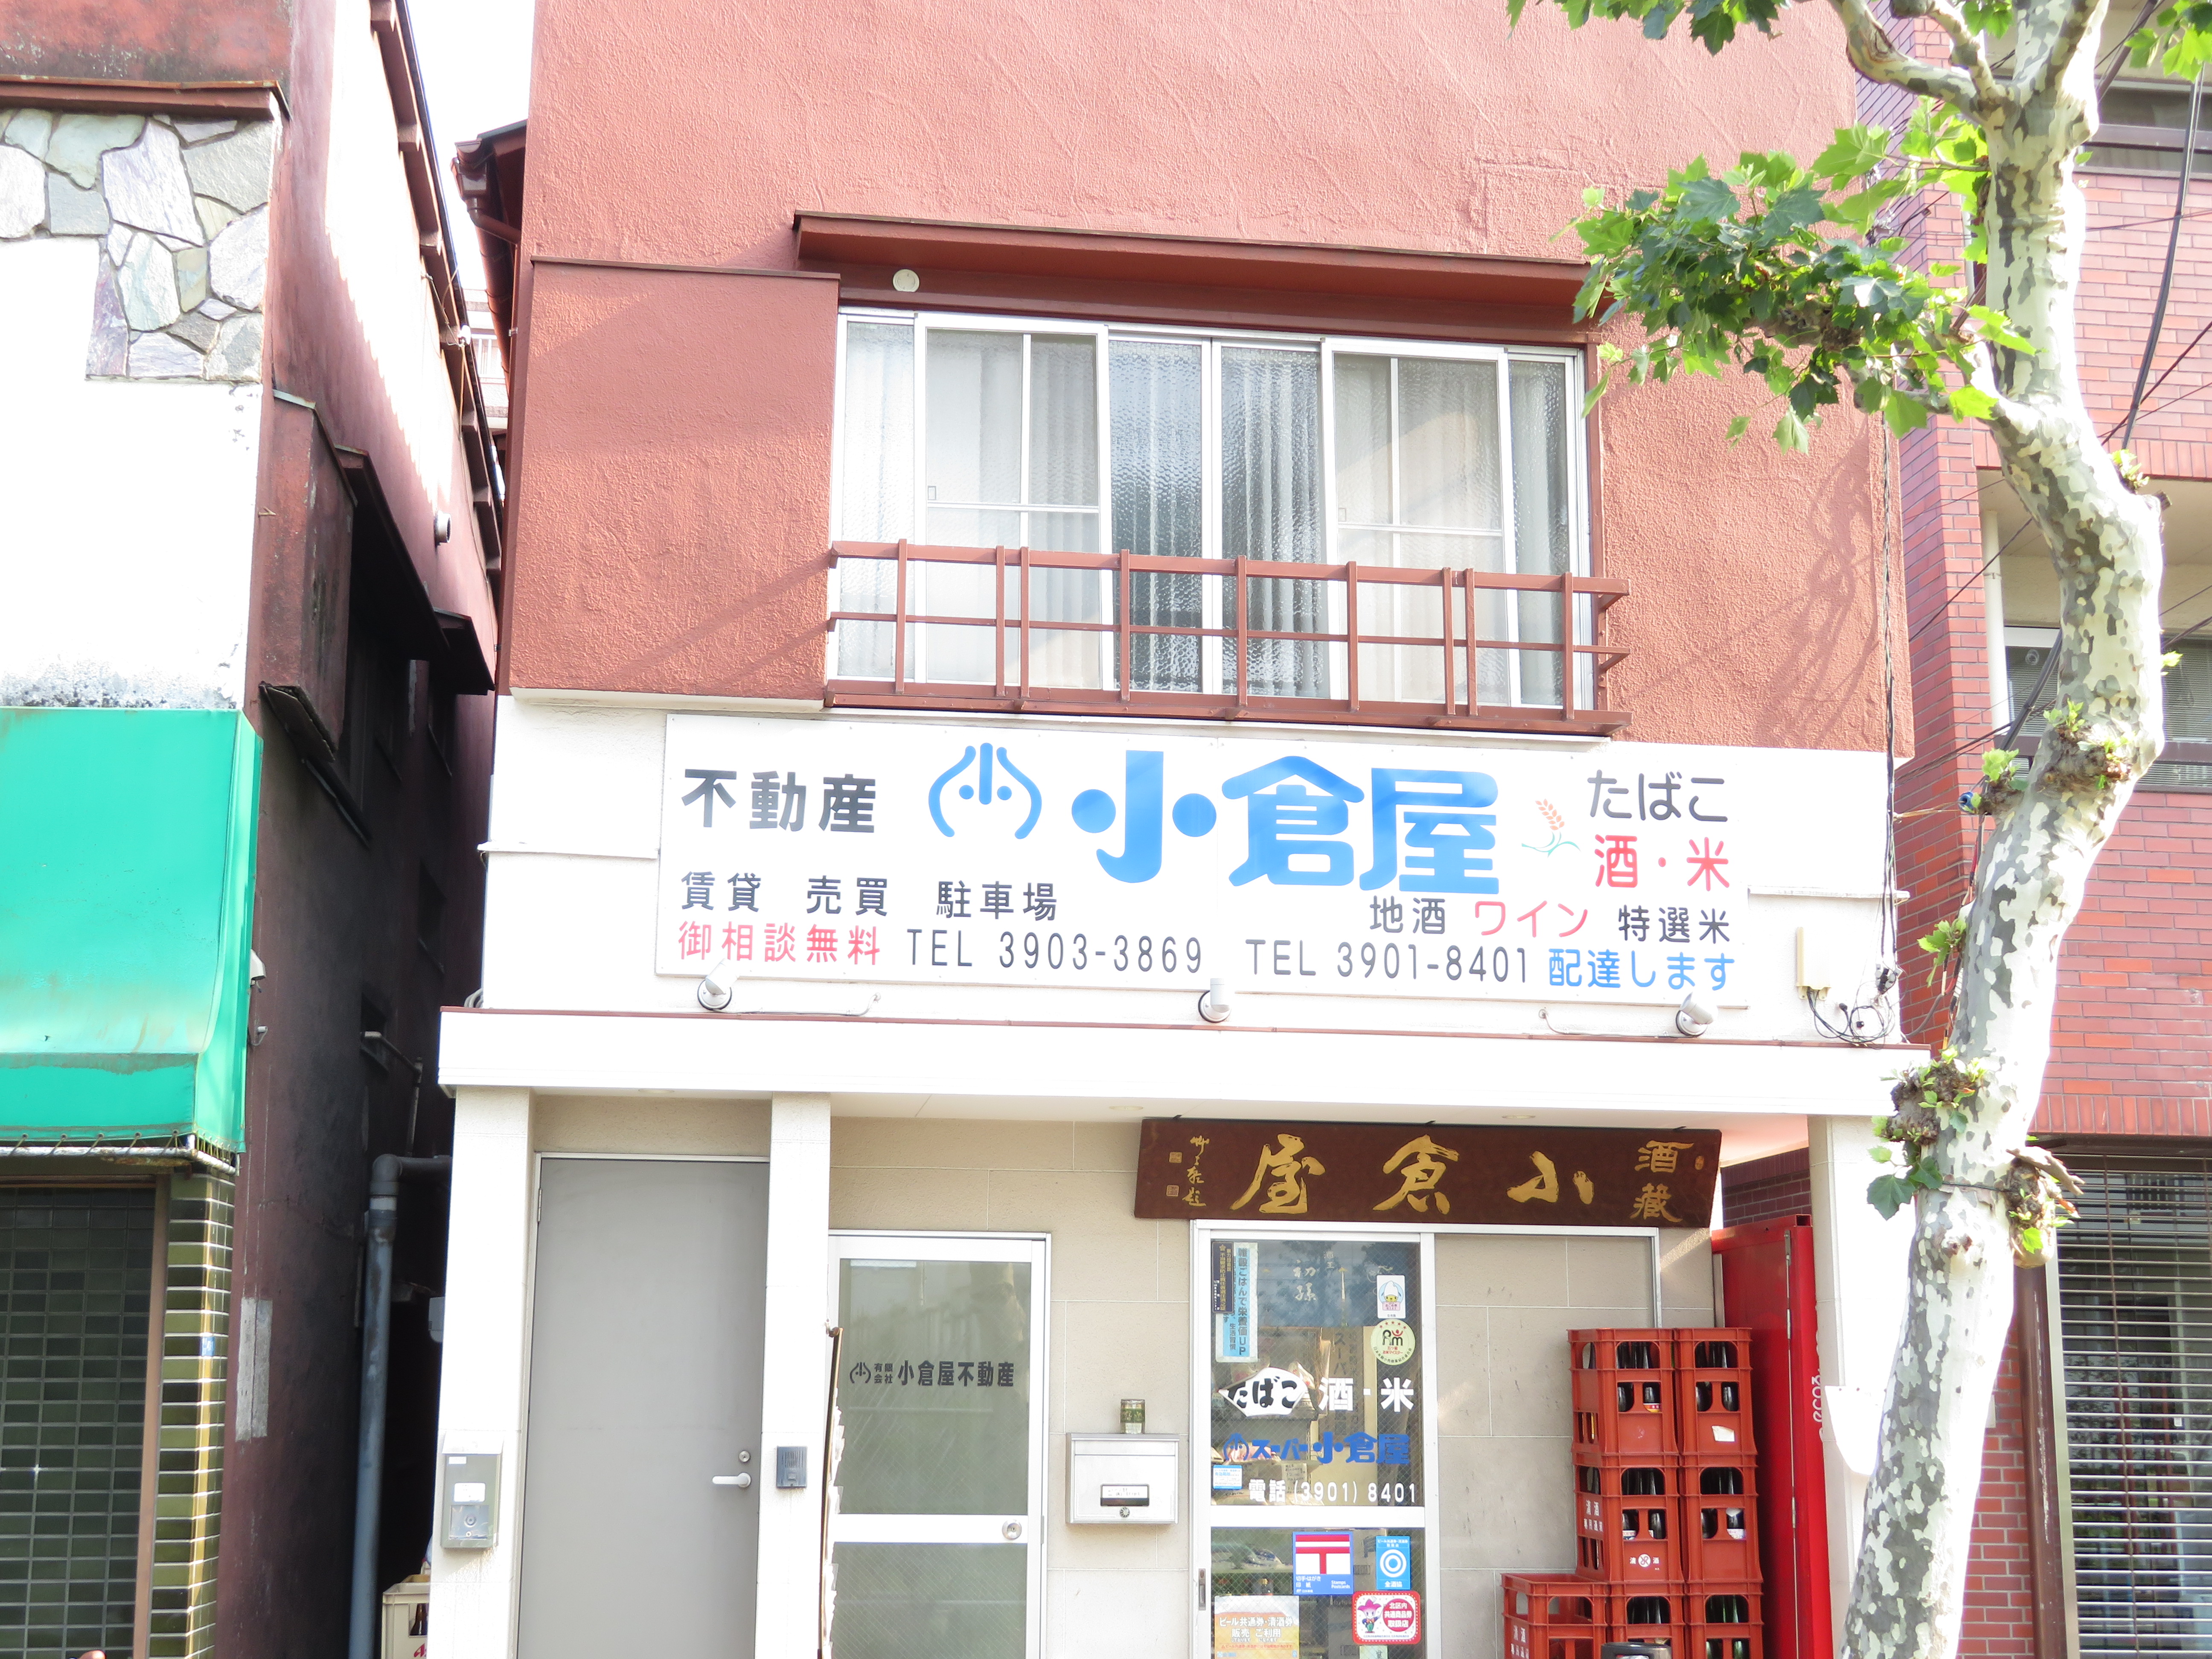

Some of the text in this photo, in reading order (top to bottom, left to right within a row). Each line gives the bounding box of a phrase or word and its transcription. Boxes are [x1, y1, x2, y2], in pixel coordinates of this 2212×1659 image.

[681, 768, 876, 833] 不動産
[1587, 769, 1728, 822] たばこ
[1071, 750, 1499, 895] 小倉屋
[1595, 834, 1730, 892] 酒・米
[681, 871, 1057, 921] 賃貸 売買 駐車場
[1370, 896, 1730, 944] 地酒 ワイン 特選米
[678, 921, 1201, 973] 御相談無料 TEL 3903-3869
[1246, 939, 1735, 991] TEL 3901-8401 配達します
[897, 1360, 1014, 1387] 小倉屋不動産
[1252, 1432, 1410, 1464] スーパー小倉屋
[1249, 1479, 1415, 1503] 電話 (3901) 8401
[1220, 1617, 1293, 1627] ビール共通券・清酒券
[1231, 1628, 1281, 1638] 販売 ご利用
